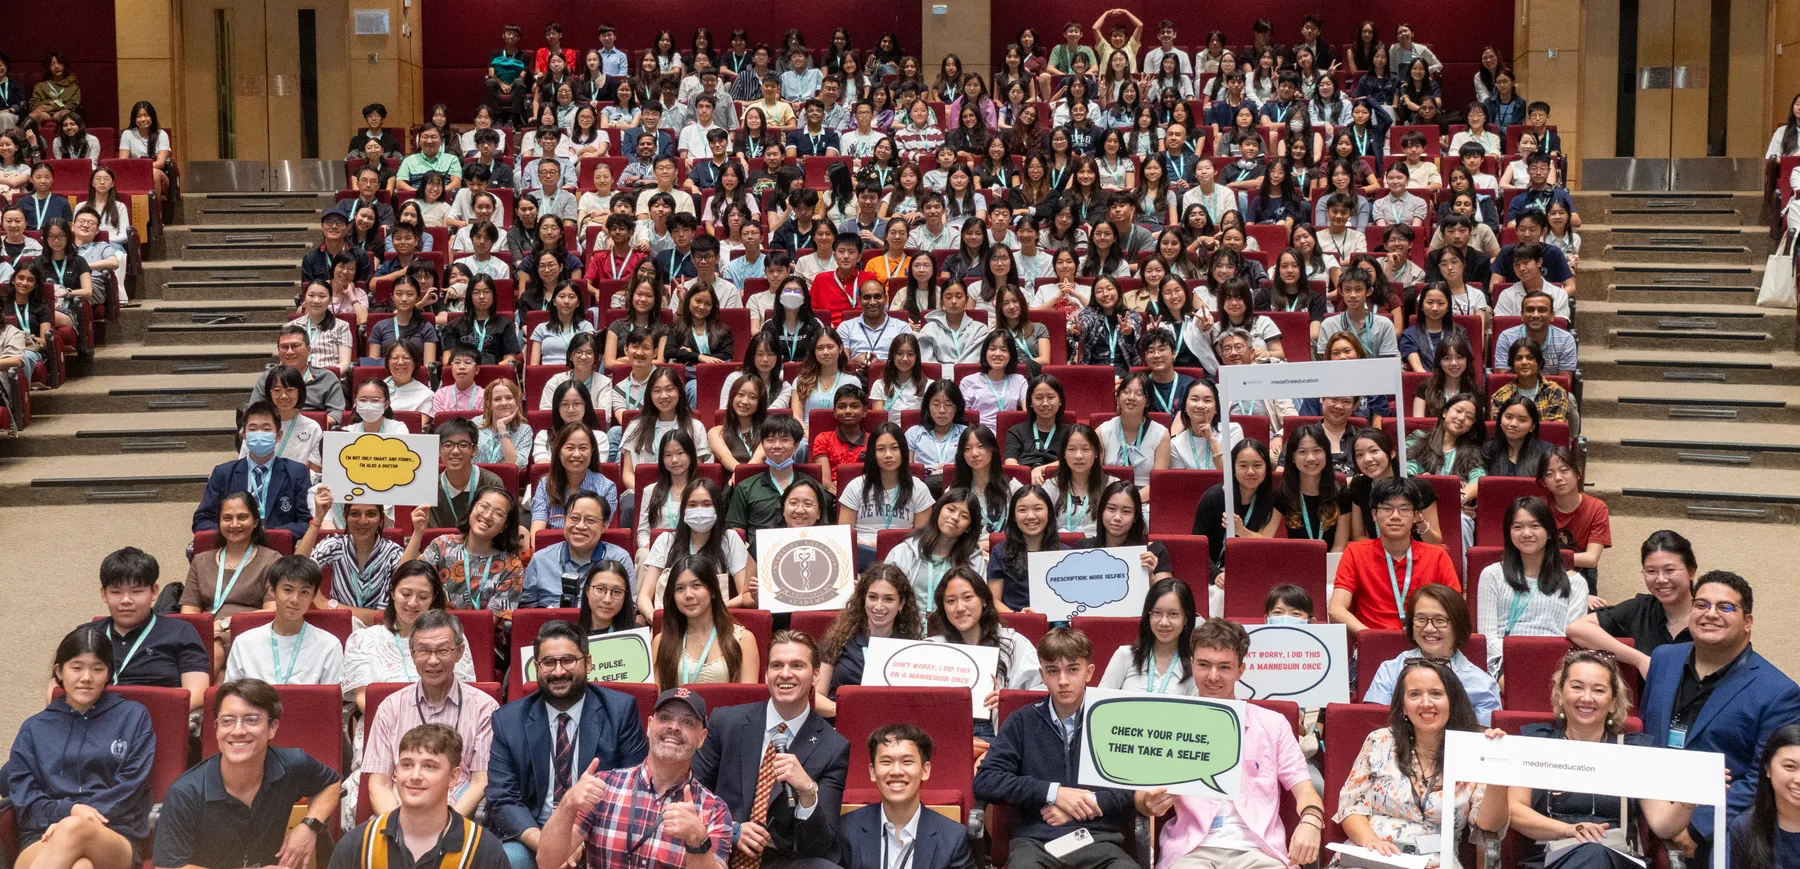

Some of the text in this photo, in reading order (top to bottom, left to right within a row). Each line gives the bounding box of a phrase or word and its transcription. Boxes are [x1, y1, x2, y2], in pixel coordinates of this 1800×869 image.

[790, 596, 825, 605] ACADEMY
[599, 660, 625, 670] PULSE,
[602, 672, 628, 682] SELFIE
[909, 673, 949, 681] MANNEQUIN
[1111, 726, 1210, 745] CHECK YOUR PULSE,
[1109, 743, 1210, 761] THEN TAKE A SELFIE
[1523, 760, 1595, 772] medefineeducation
